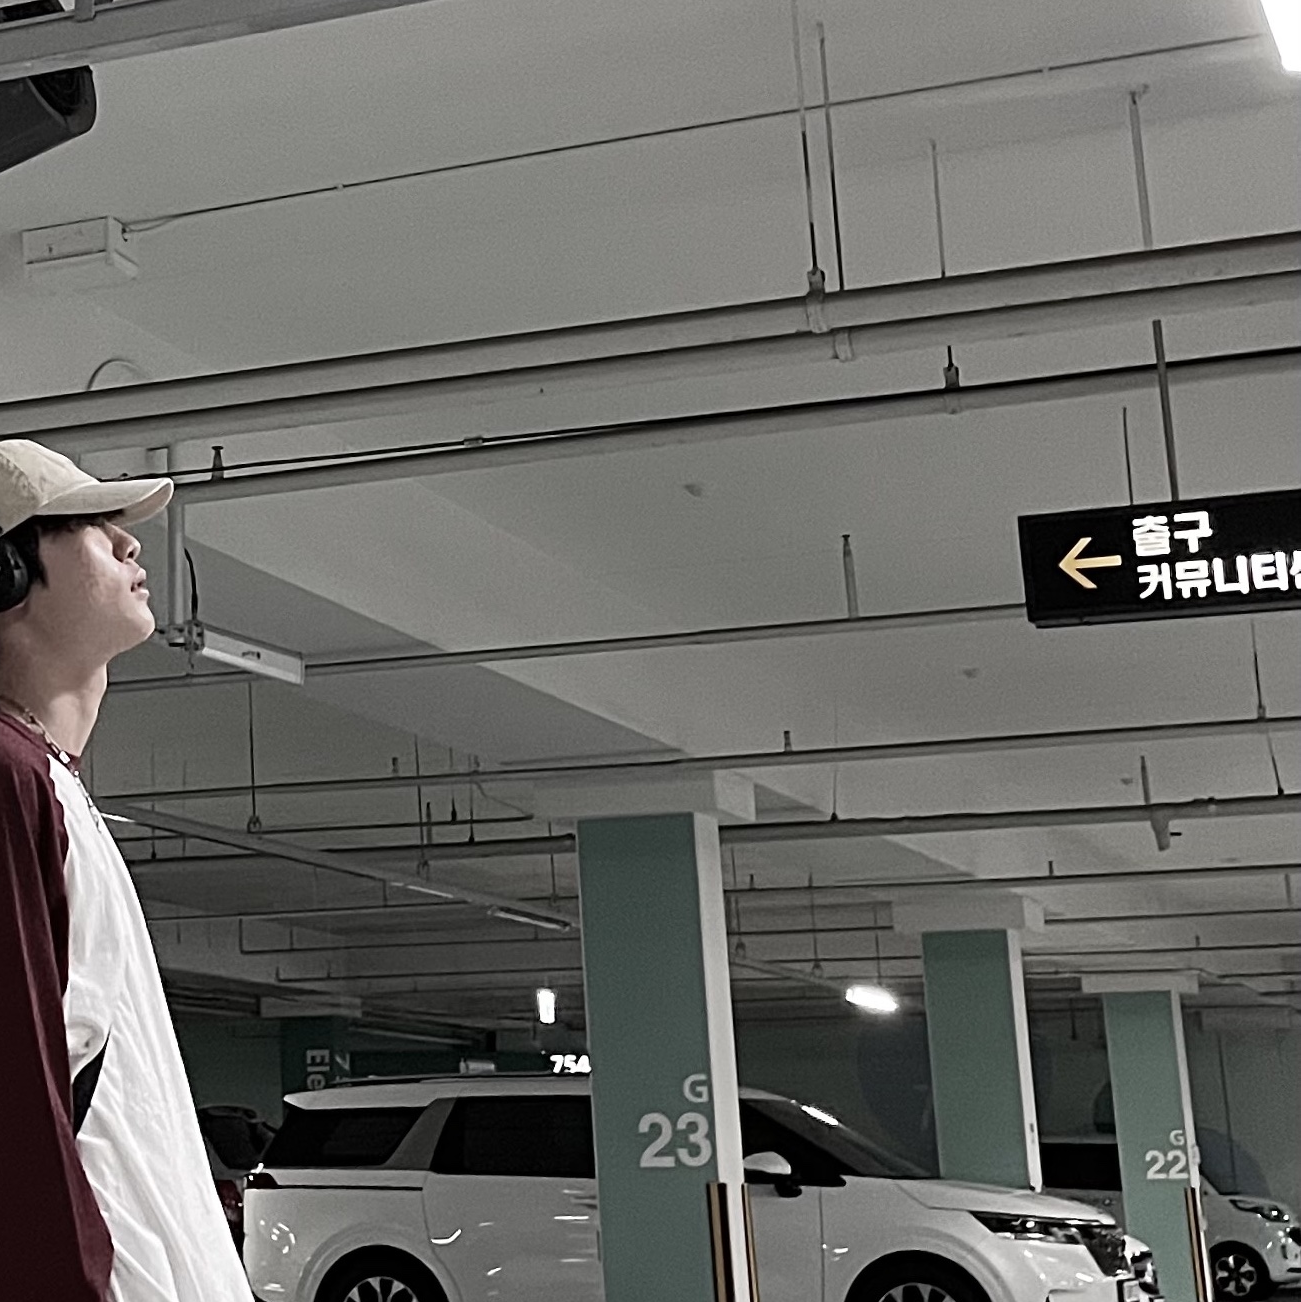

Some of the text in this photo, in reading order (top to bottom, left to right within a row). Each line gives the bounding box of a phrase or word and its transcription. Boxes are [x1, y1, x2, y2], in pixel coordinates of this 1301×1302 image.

[1132, 511, 1213, 557] 출구
[683, 1073, 710, 1103] G
[638, 1111, 713, 1168] 23
[1169, 1129, 1185, 1146] G
[1145, 1149, 1189, 1180] 22
